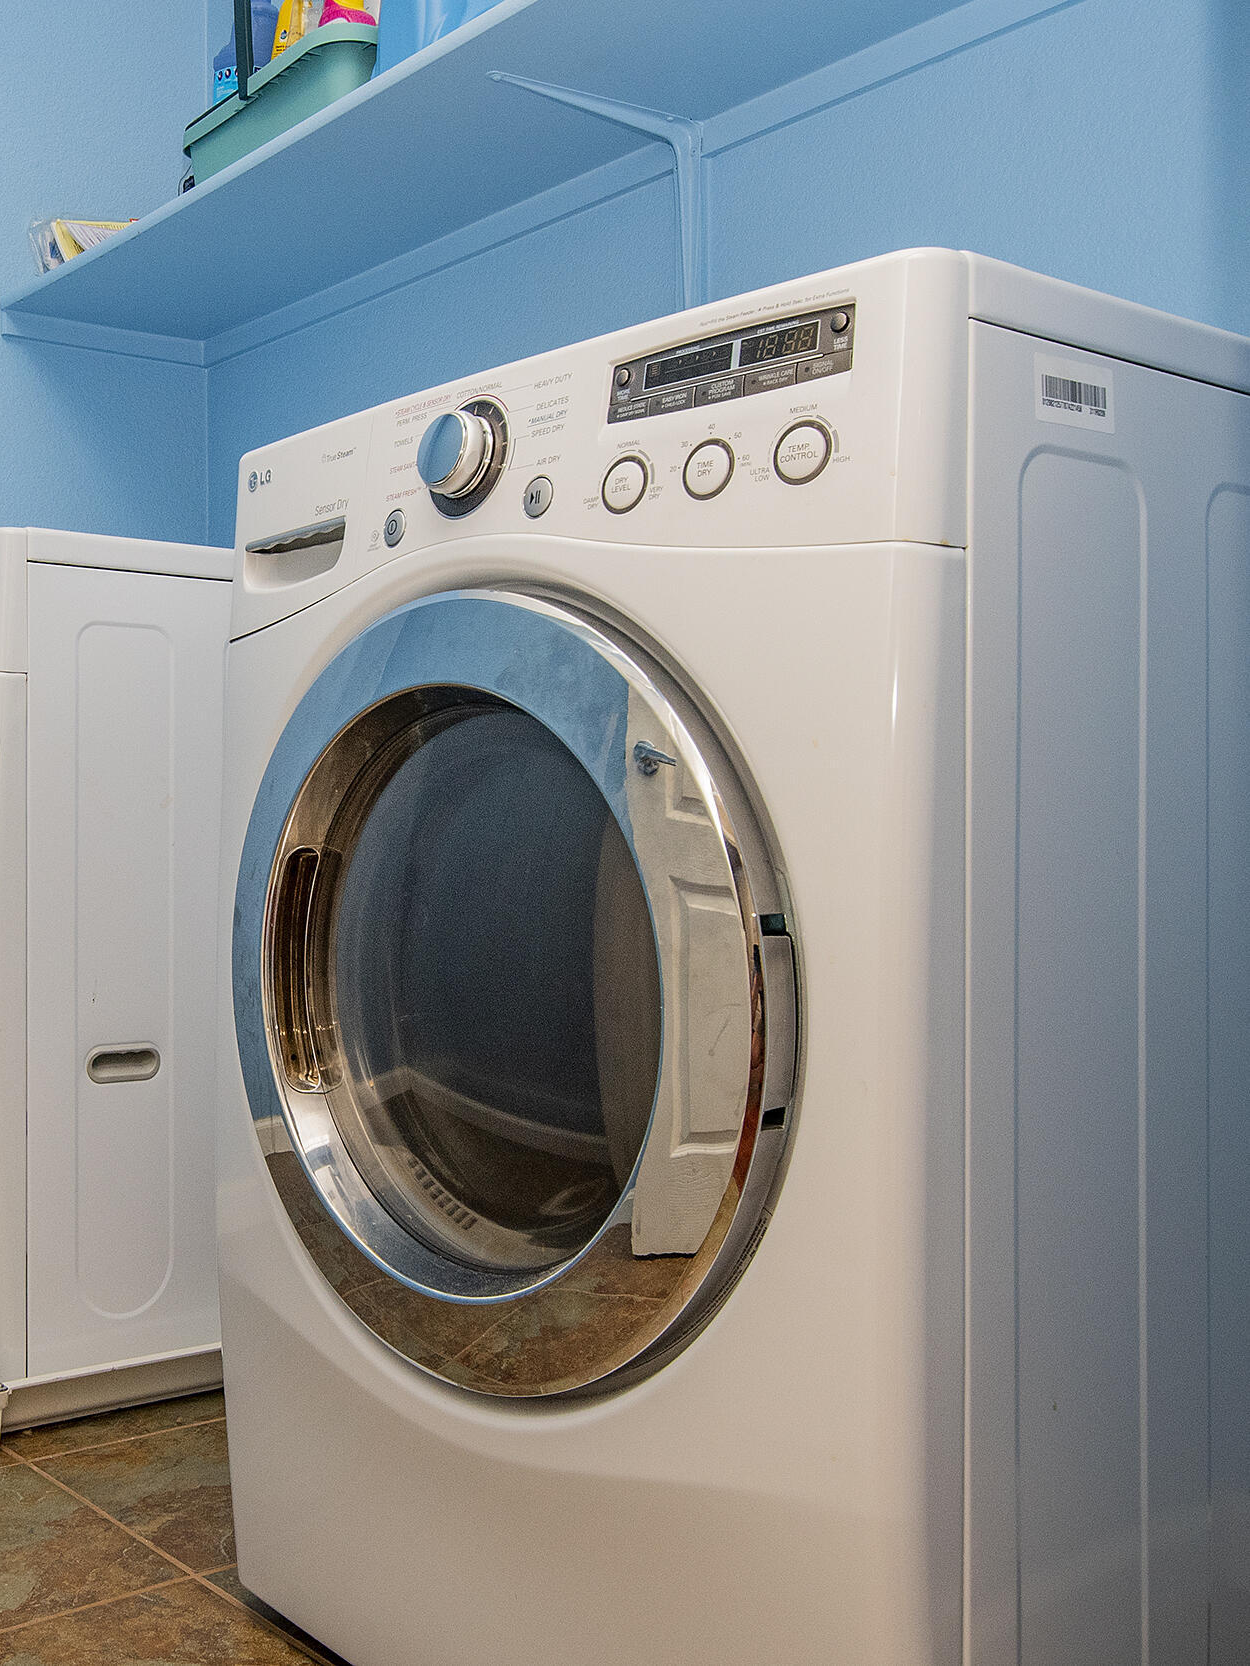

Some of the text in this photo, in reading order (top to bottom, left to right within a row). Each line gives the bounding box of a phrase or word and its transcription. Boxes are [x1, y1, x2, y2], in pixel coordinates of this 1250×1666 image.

[833, 336, 849, 345] LESS
[834, 342, 848, 351] TIME
[533, 371, 574, 390] HEAVY DUTY
[708, 384, 736, 395] PROGRAM
[535, 396, 570, 410] DELICATES
[789, 403, 818, 414] MEDIUM
[555, 409, 568, 419] DRY
[530, 424, 566, 438] SPEED DRY
[616, 440, 641, 449] NORMAL
[536, 454, 562, 467] AIR DRY
[779, 450, 819, 464] CONTROL
[832, 456, 851, 464] HIGH
[697, 460, 714, 469] TIME
[697, 468, 712, 477] DRY
[750, 466, 771, 476] ULTRA
[260, 469, 272, 486] LG
[615, 476, 629, 485] DRY
[754, 474, 770, 482] LOW
[611, 484, 631, 494] LEVEL
[314, 498, 350, 516] Sensor Dry
